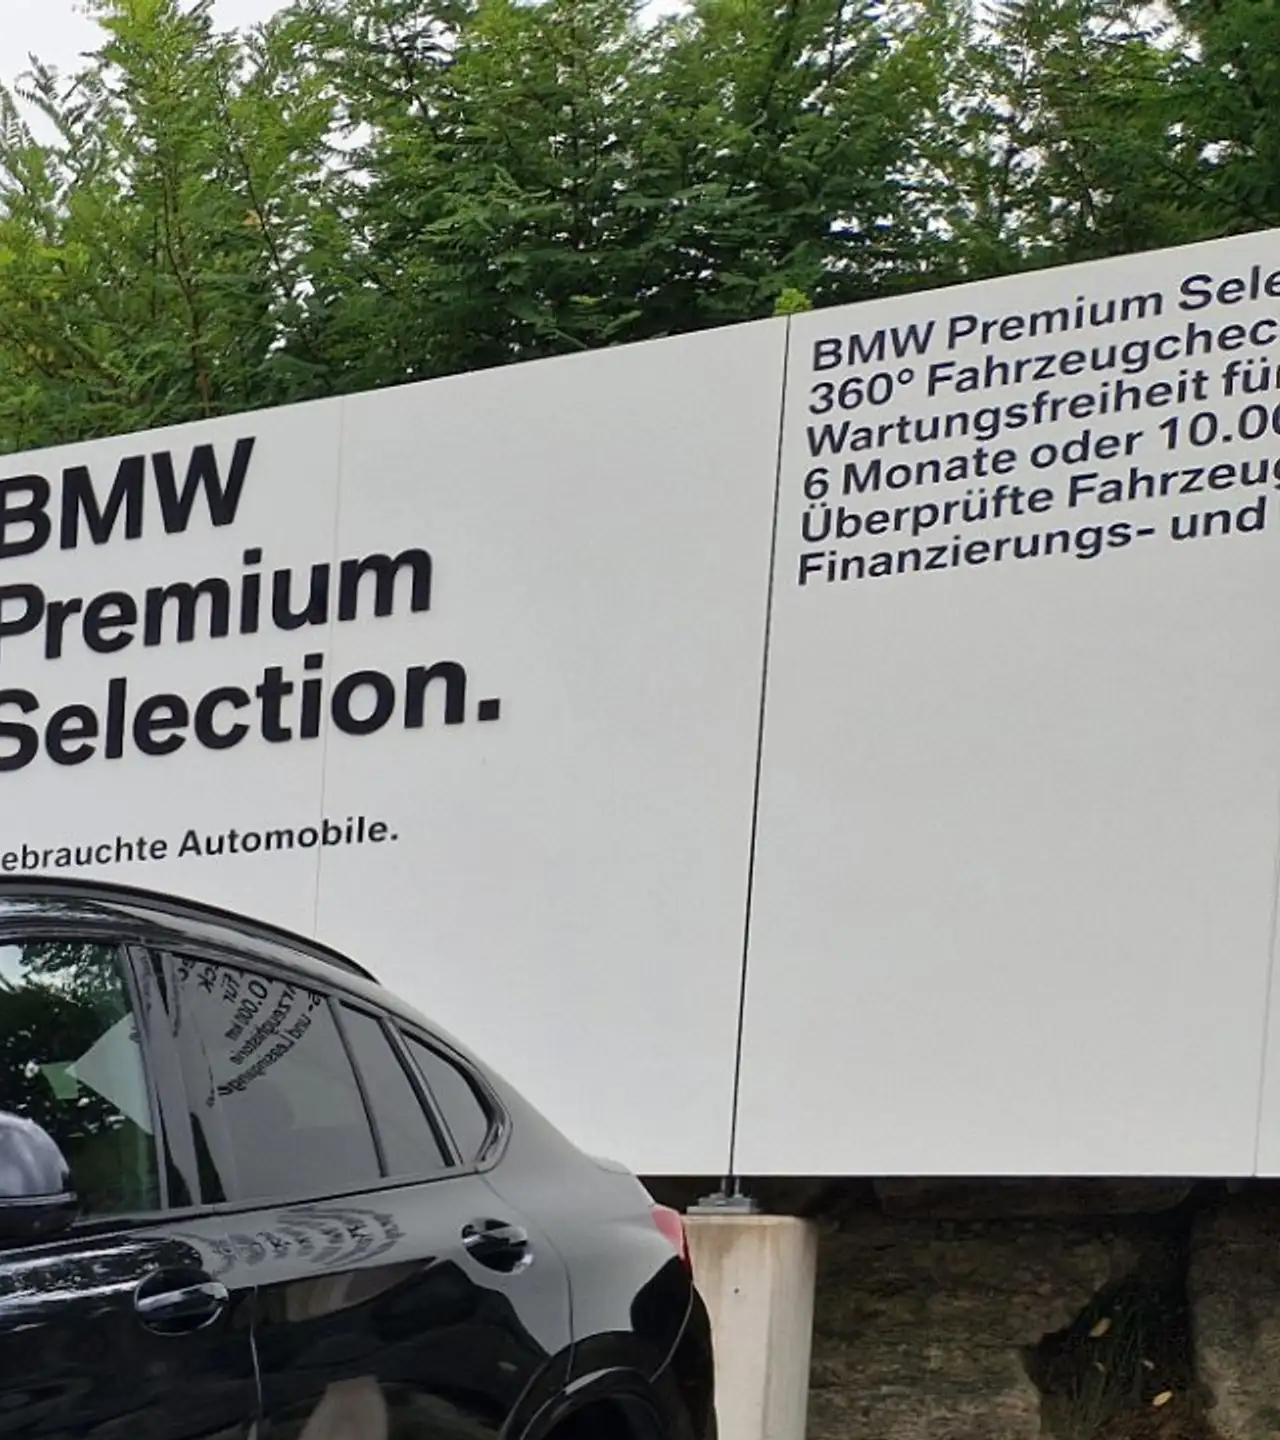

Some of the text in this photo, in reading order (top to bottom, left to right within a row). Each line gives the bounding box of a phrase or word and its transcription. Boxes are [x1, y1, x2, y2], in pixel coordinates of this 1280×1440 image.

[813, 320, 936, 373] BMW
[947, 292, 1163, 350] Premium
[806, 369, 1209, 457] Wartungsfreiheit
[809, 367, 915, 415] 360°
[804, 403, 1280, 500] 6 Monate oder 10.0
[798, 495, 1267, 586] Finanzierungs- und
[802, 458, 1280, 543] Überprüfte Fahrzeu
[178, 816, 400, 857] Automobile.
